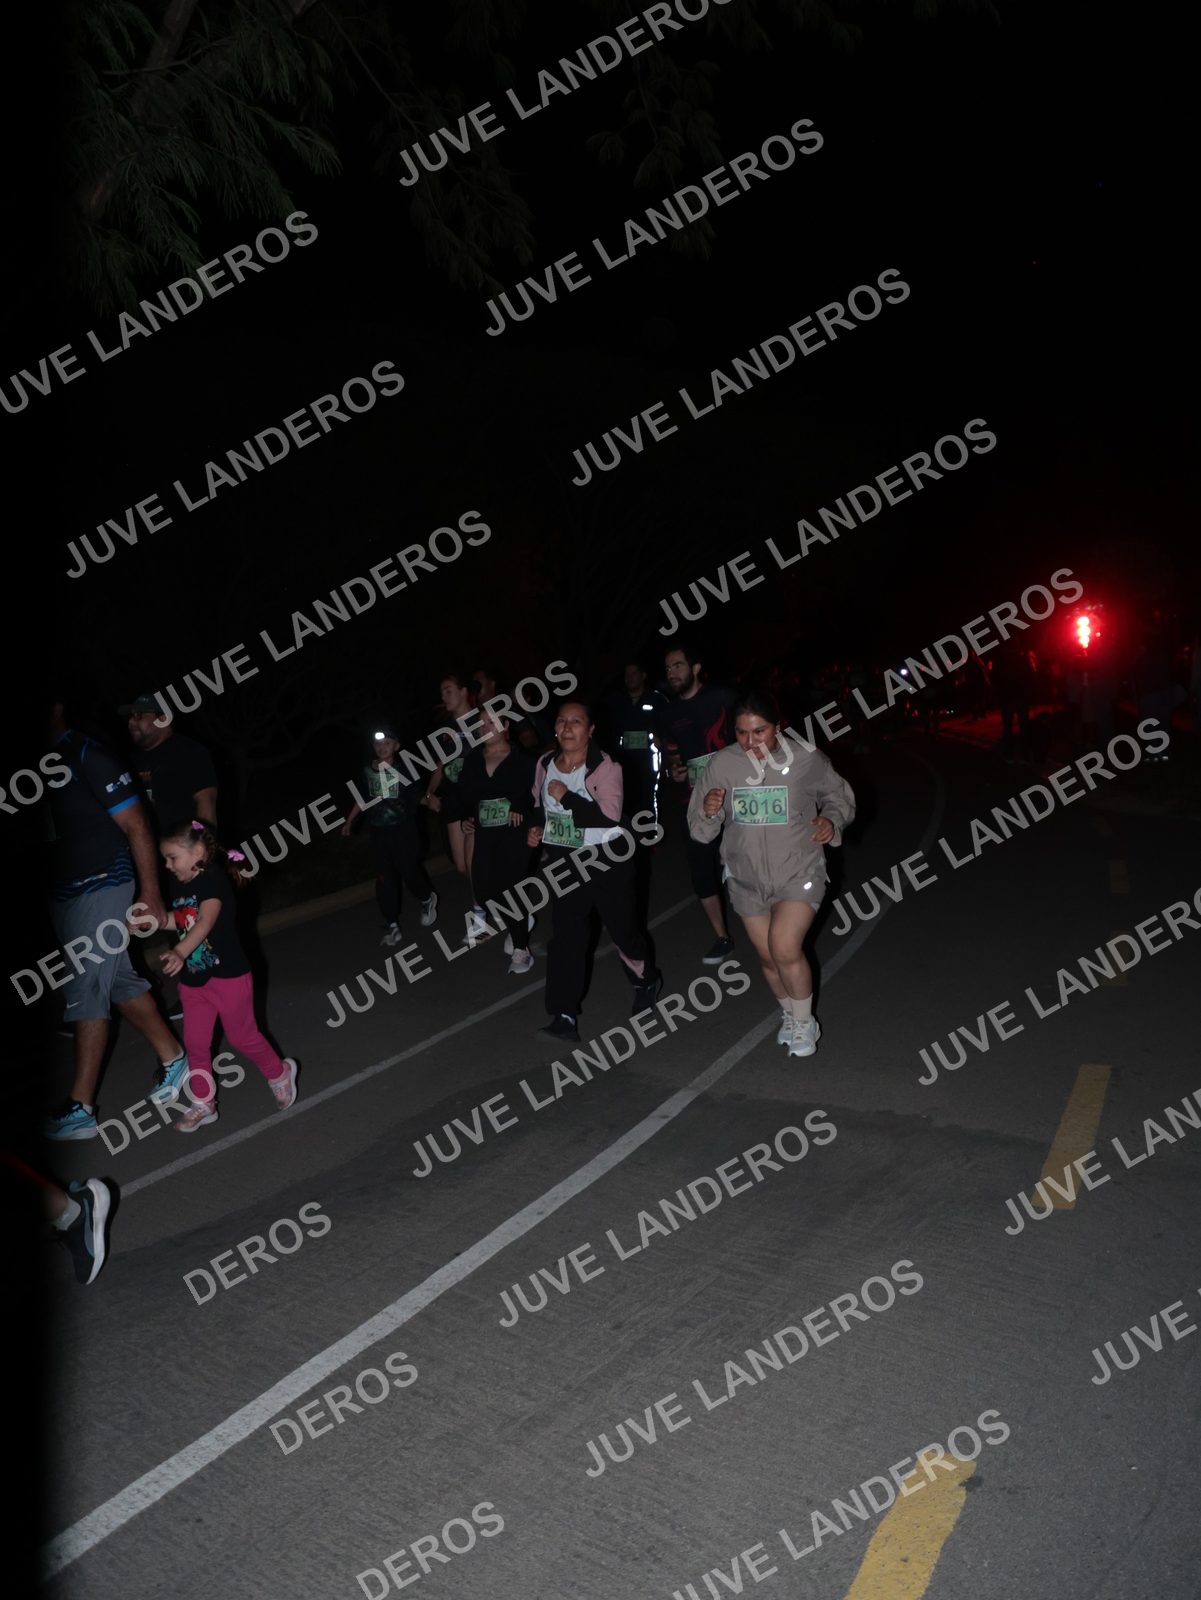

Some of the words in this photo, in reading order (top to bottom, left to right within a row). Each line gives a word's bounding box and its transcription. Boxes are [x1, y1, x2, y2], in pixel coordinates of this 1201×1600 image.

[484, 806, 506, 820] 725
[738, 799, 782, 816] 3016
[550, 821, 582, 839] 3015
